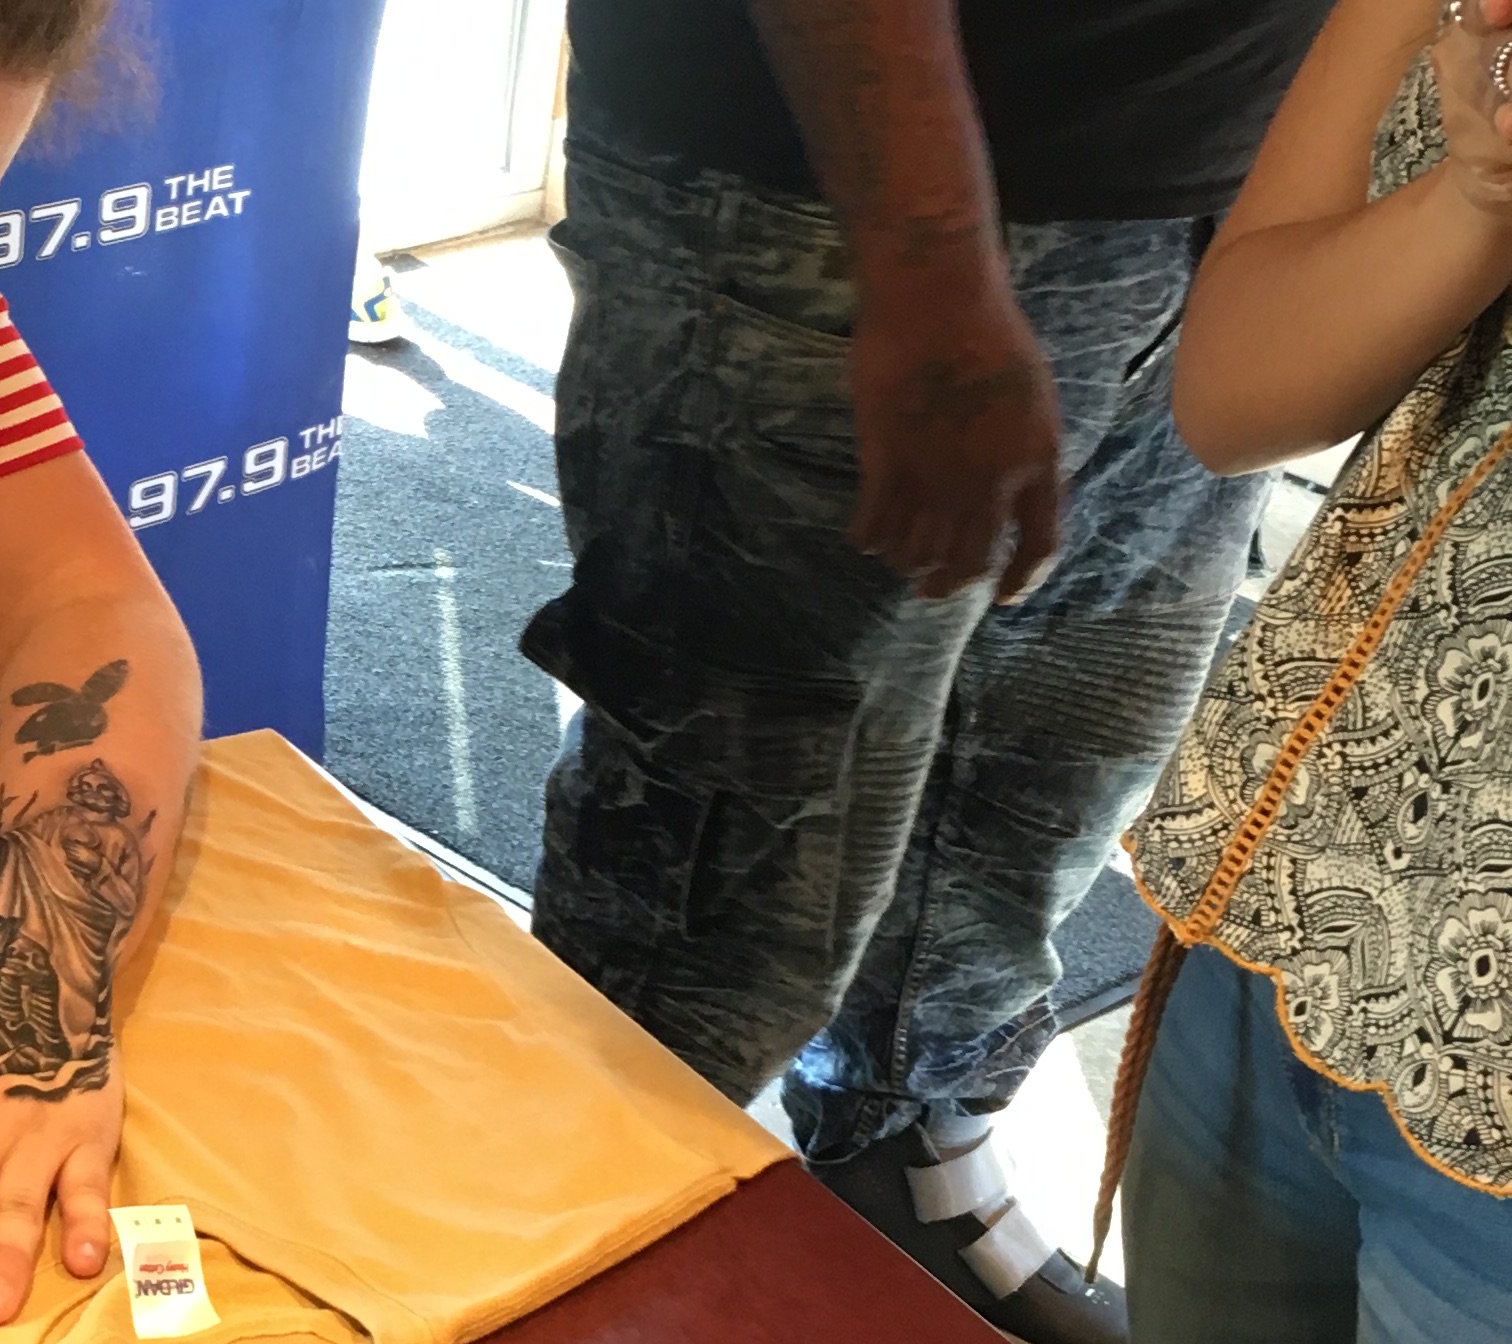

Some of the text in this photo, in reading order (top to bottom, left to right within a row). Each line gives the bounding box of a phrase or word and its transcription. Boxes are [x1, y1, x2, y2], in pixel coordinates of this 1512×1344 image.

[164, 163, 235, 200] THE
[155, 190, 252, 233] BEAT
[128, 436, 289, 531] 97.9
